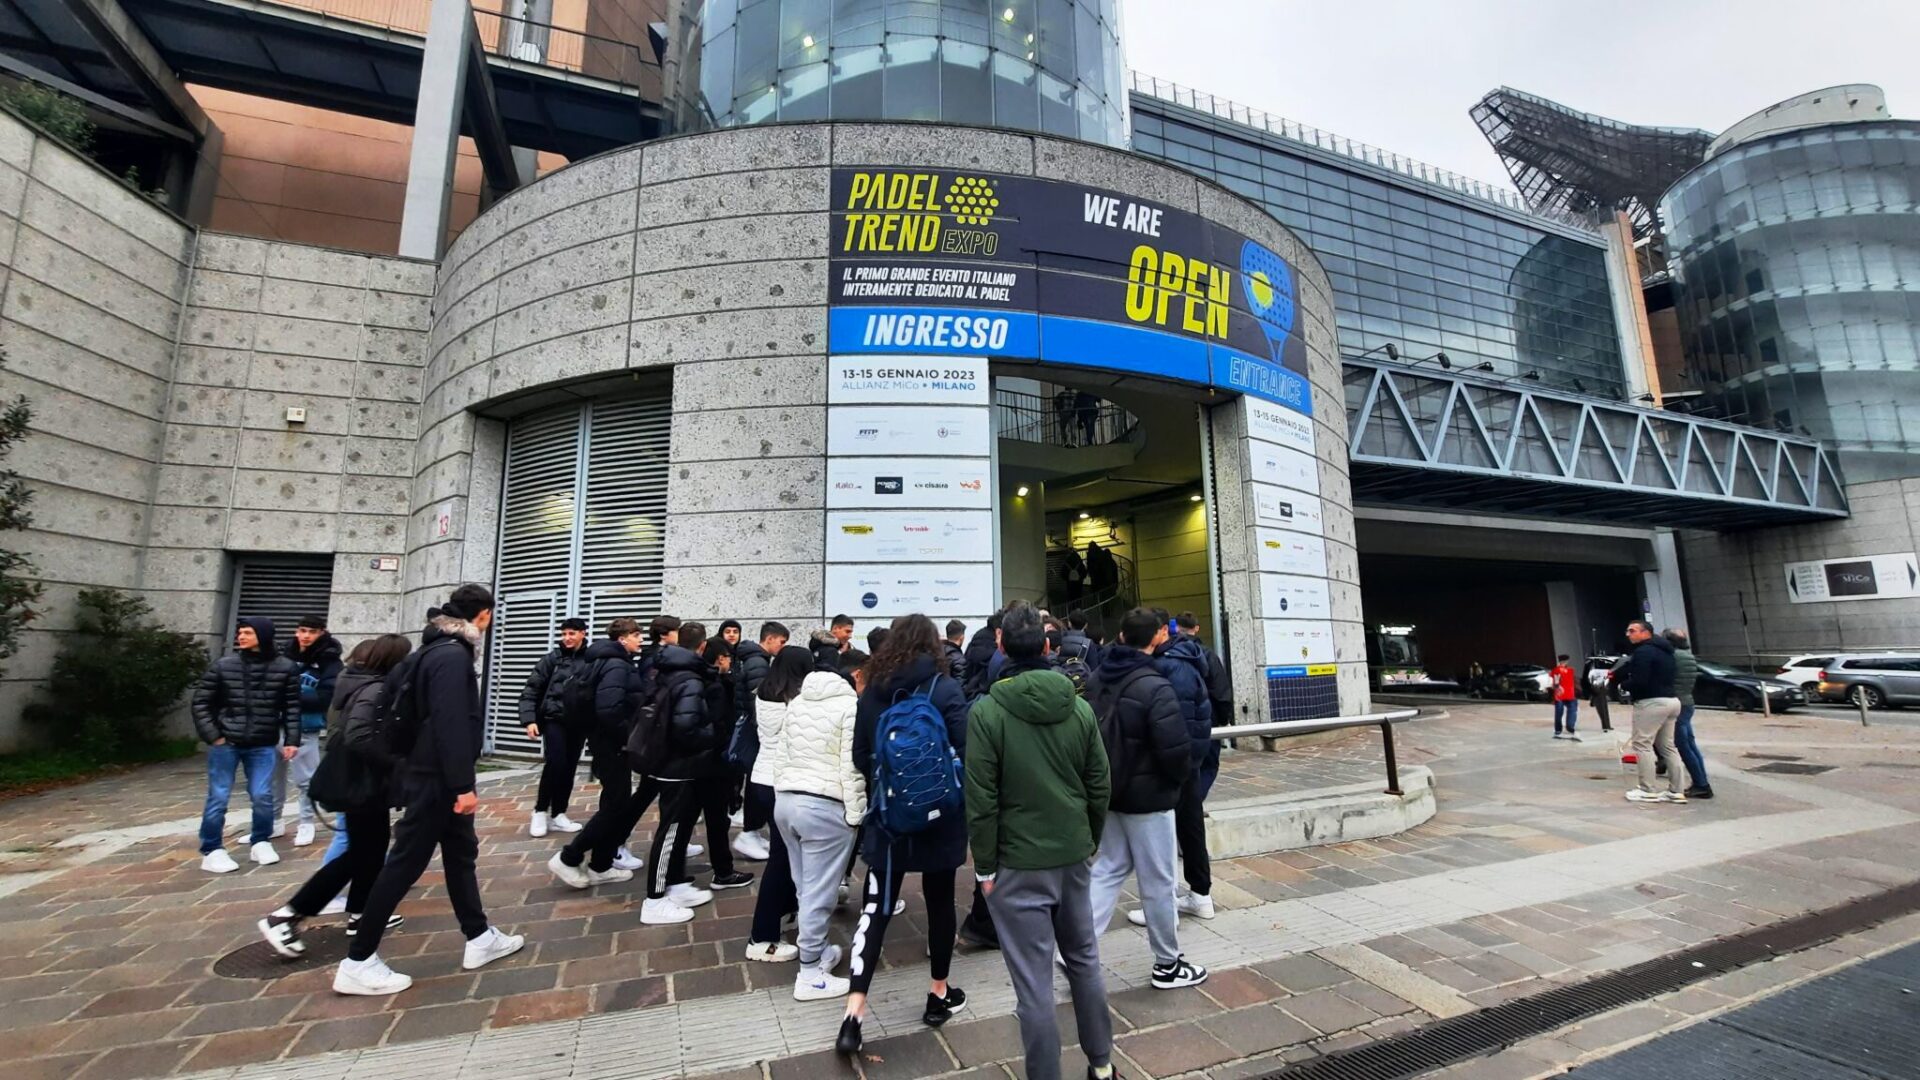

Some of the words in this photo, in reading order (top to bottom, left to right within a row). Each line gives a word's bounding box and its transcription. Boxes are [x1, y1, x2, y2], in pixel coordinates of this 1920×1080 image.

[848, 174, 941, 210] PADEL
[1084, 193, 1120, 227] WE
[1123, 203, 1163, 237] ARE
[844, 214, 941, 252] TREND
[941, 229, 998, 255] EXPO
[843, 267, 853, 281] IL
[855, 268, 888, 281] PRIMO
[890, 268, 930, 282] GRANDE
[932, 269, 970, 283] EVENTO
[972, 271, 1016, 287] ITALIANO
[843, 282, 913, 296] INTERAMENTE
[915, 283, 964, 298] DEDICATO
[965, 285, 978, 299] AL
[980, 286, 1010, 301] PADEL
[1125, 245, 1230, 339] OPEN
[863, 314, 1008, 349] INGRESSO
[842, 369, 873, 379] 13-15
[877, 369, 939, 379] GENNAIO
[943, 369, 975, 380] 2023
[842, 381, 889, 390] ALLIANZ
[892, 381, 919, 390] MiCo
[931, 382, 976, 391] MILANO
[1229, 356, 1301, 406] ENTRANCE
